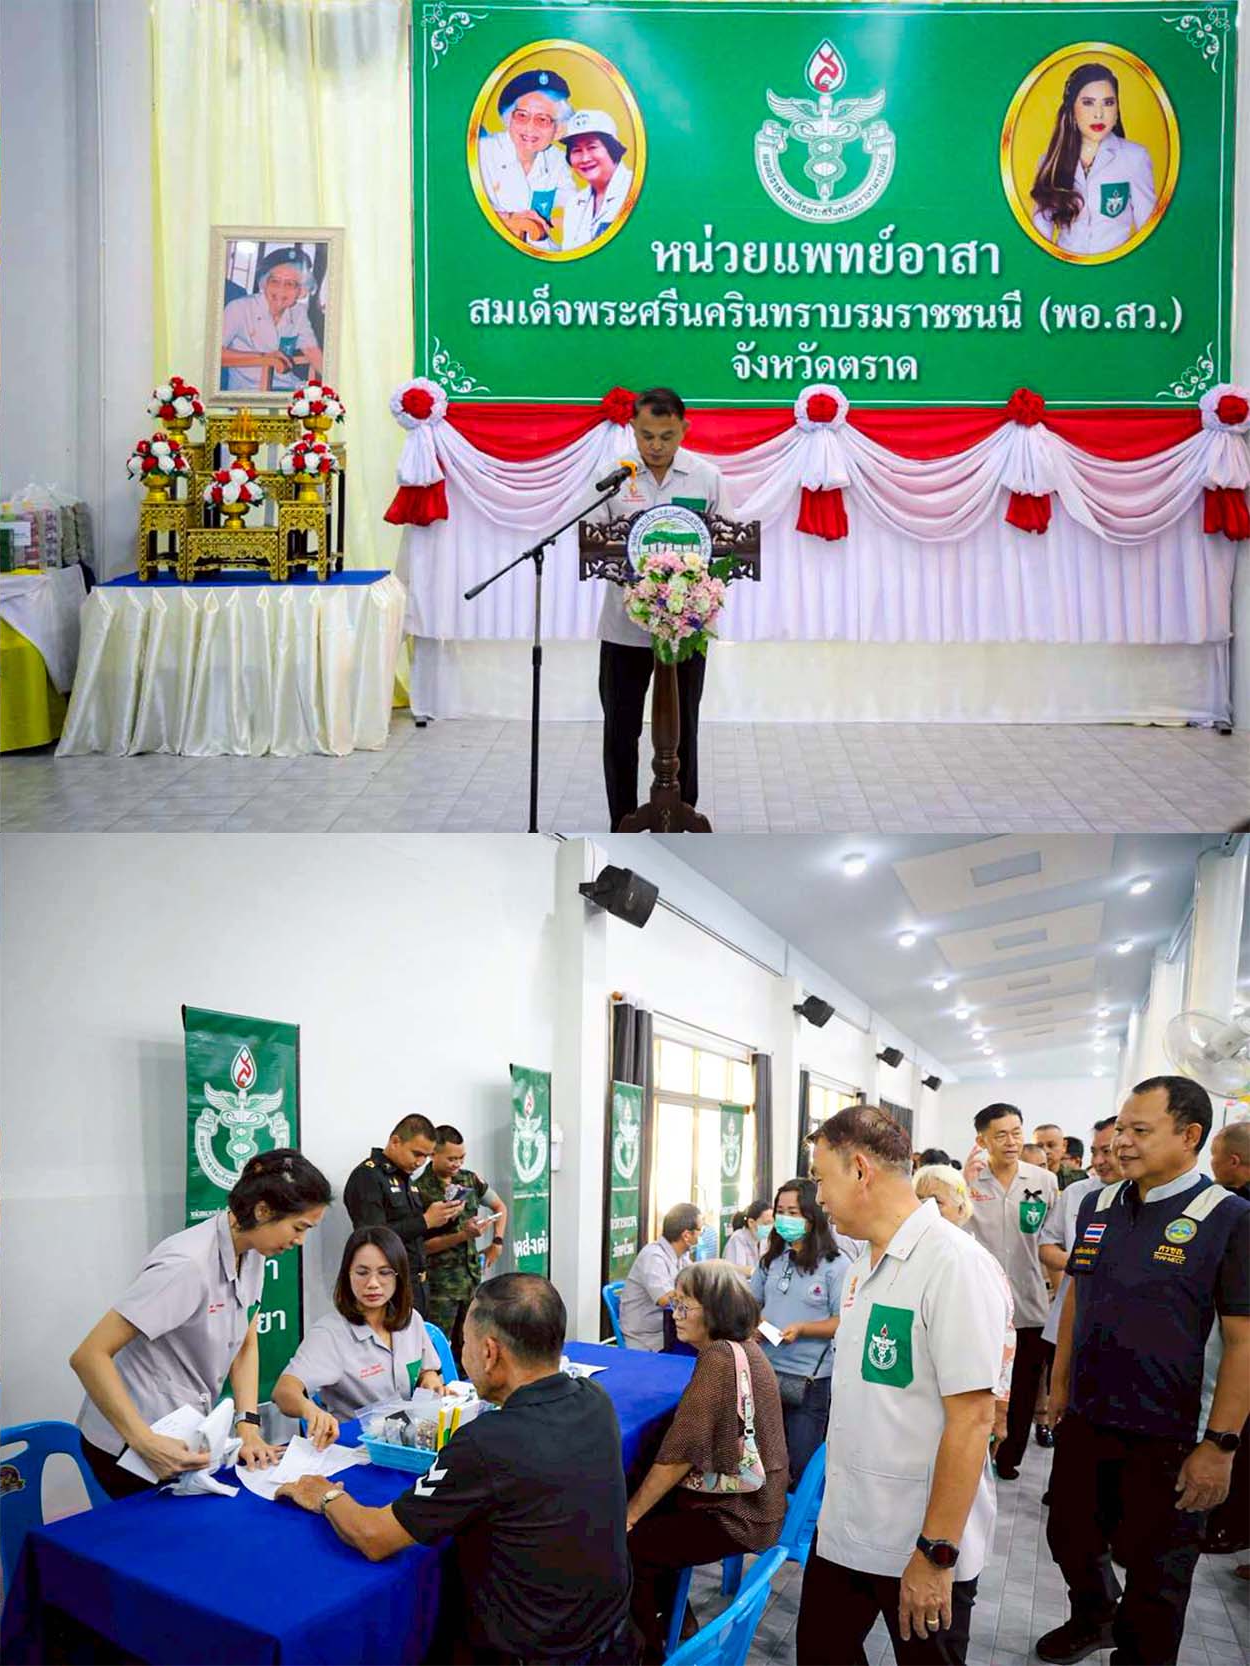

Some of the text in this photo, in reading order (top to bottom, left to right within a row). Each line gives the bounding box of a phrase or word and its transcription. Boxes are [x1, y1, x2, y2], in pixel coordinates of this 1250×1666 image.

[651, 225, 1001, 275] หน่วยแพทย์อาสา
[469, 284, 1185, 333] สมเด็จพระศรีนครินทราบรมราชชนนี (พอ.สว.)
[731, 342, 919, 381] จังหวัดตราด
